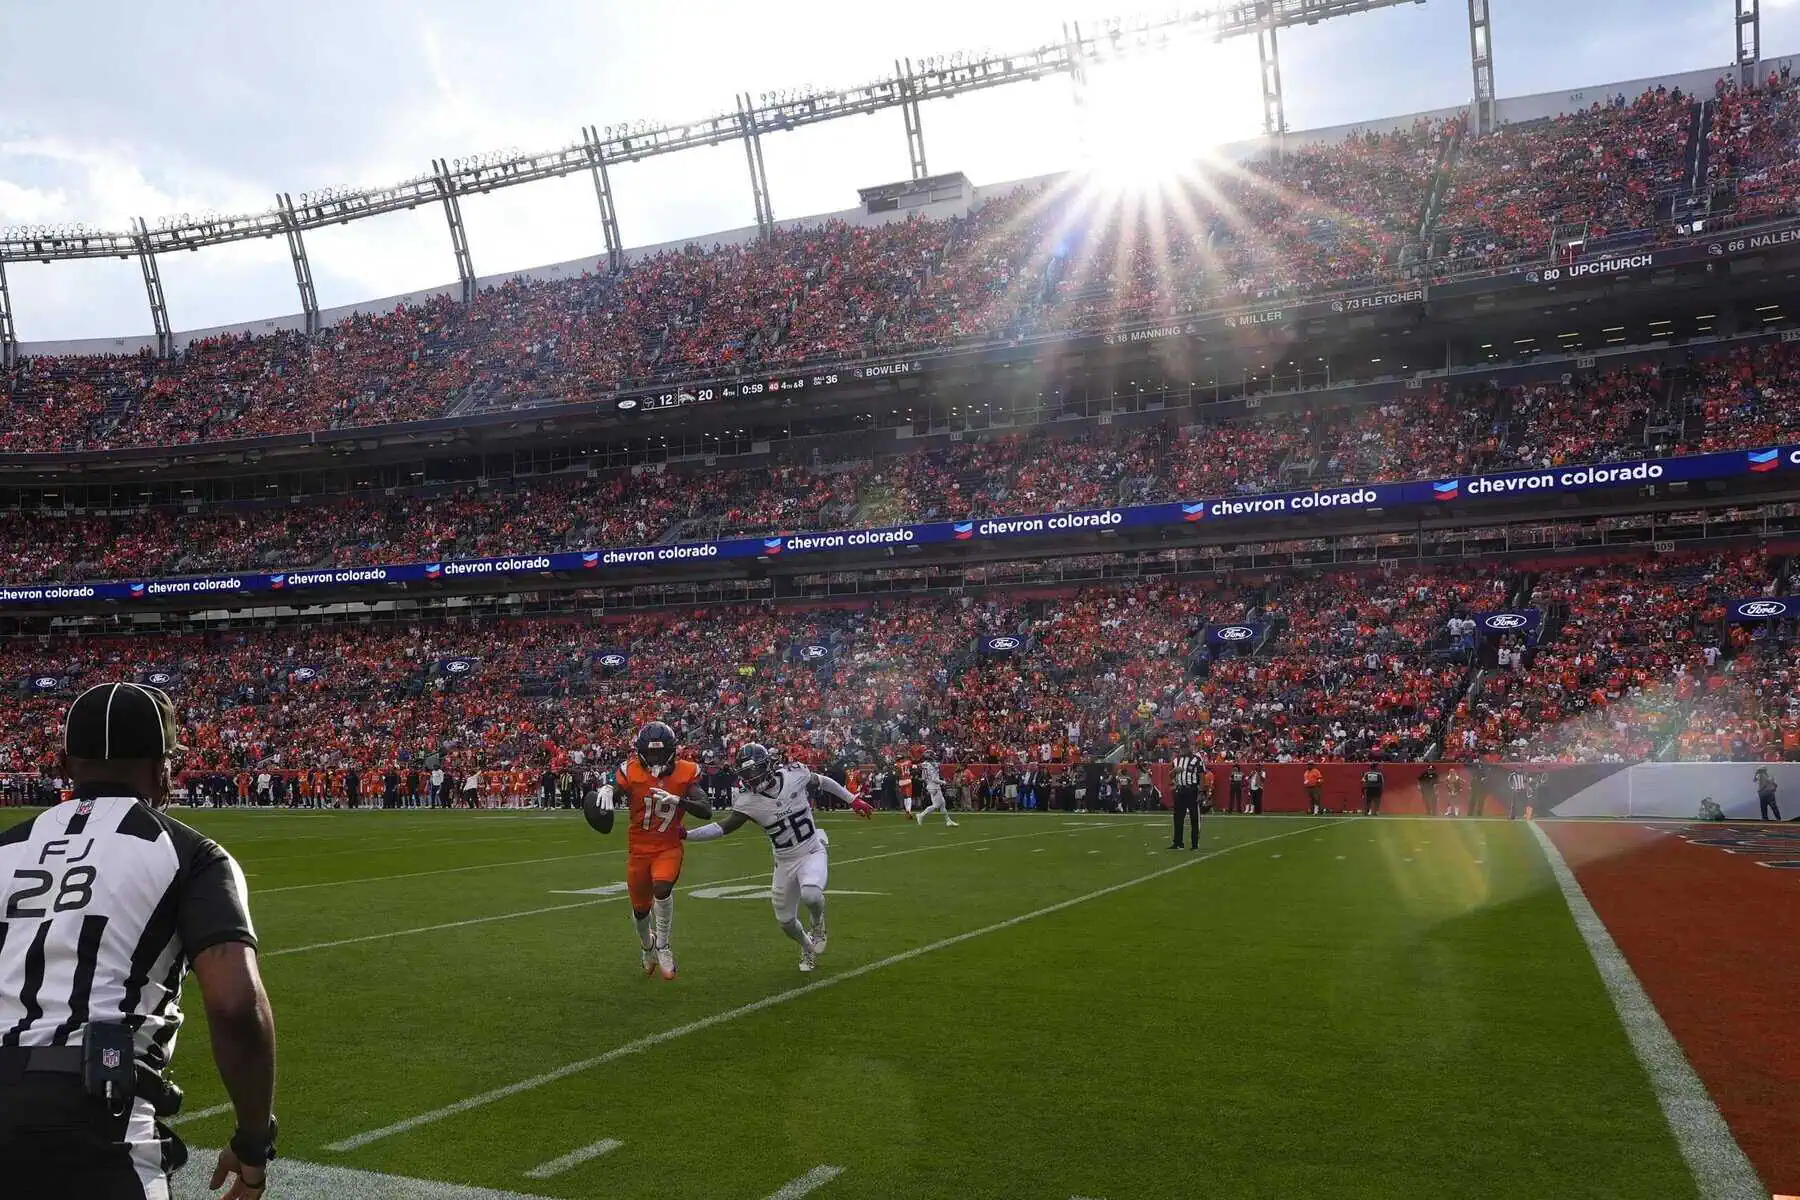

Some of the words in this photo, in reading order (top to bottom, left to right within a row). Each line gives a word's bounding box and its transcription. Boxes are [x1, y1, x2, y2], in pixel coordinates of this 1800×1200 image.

[1728, 240, 1745, 252] 66
[1750, 229, 1800, 248] NALEN
[1543, 269, 1560, 281] 80
[1569, 253, 1653, 277] UPCHURCH
[1346, 299, 1360, 310] 73
[1361, 290, 1422, 308] FLETCHER
[1239, 311, 1282, 325] MILLER
[1117, 333, 1128, 344] 18
[1131, 325, 1181, 342] MANNING
[866, 362, 909, 377] BOWLEN
[659, 394, 673, 406] 12
[699, 389, 713, 401] 20
[742, 383, 764, 395] 0:59
[769, 382, 779, 391] 40
[826, 374, 838, 385] 36
[1468, 475, 1554, 494] chevron
[1561, 462, 1663, 486] colorado
[1211, 498, 1285, 516] chevron
[1291, 489, 1377, 509] colorado
[979, 518, 1043, 535] chevron
[1048, 510, 1122, 529] colorado
[787, 535, 844, 550] chevron
[848, 528, 914, 545] colorado
[1655, 542, 1674, 551] 109
[603, 549, 655, 563] chevron
[658, 543, 717, 560] colorado
[444, 562, 492, 575] chevron
[495, 556, 550, 571] colorado
[148, 582, 190, 594] chevron
[193, 578, 241, 590] colorado
[288, 573, 333, 585] chevron
[335, 569, 386, 581] colorado
[45, 587, 94, 598] colorado
[1744, 603, 1780, 616] Ford
[1490, 615, 1521, 627] Ford
[992, 638, 1016, 649] Ford
[1222, 627, 1249, 640] Ford
[642, 797, 680, 832] 19
[764, 808, 815, 849] 26
[39, 838, 95, 864] FJ
[6, 866, 97, 918] 28
